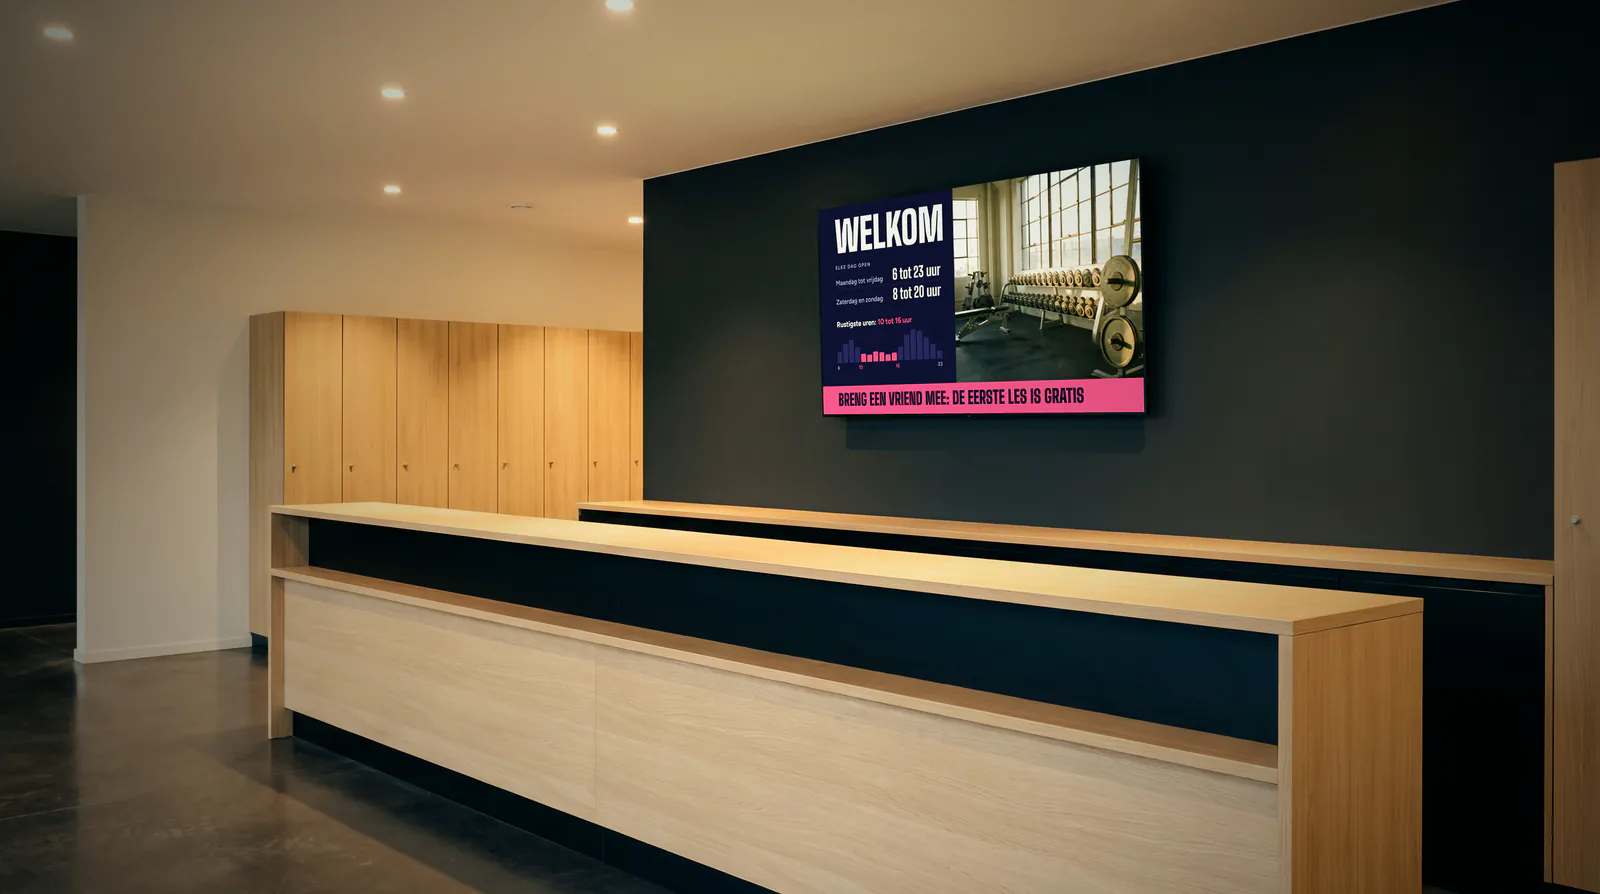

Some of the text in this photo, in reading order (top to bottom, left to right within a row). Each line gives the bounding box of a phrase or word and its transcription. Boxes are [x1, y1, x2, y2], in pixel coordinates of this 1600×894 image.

[835, 204, 943, 254] WELKOM
[835, 278, 858, 286] Maandag
[866, 276, 884, 284] vrijdag
[892, 267, 898, 280] 6
[899, 266, 912, 280] tot
[913, 264, 924, 278] 23
[926, 265, 941, 277] uur
[892, 287, 898, 300] 8
[899, 286, 913, 300] tot
[913, 285, 924, 298] 20
[926, 286, 941, 297] uur
[836, 320, 862, 329] Rustigste
[838, 387, 1085, 407] BRENG EEN VRIEND MEE: DE EERSTE LES IS GRATIS
